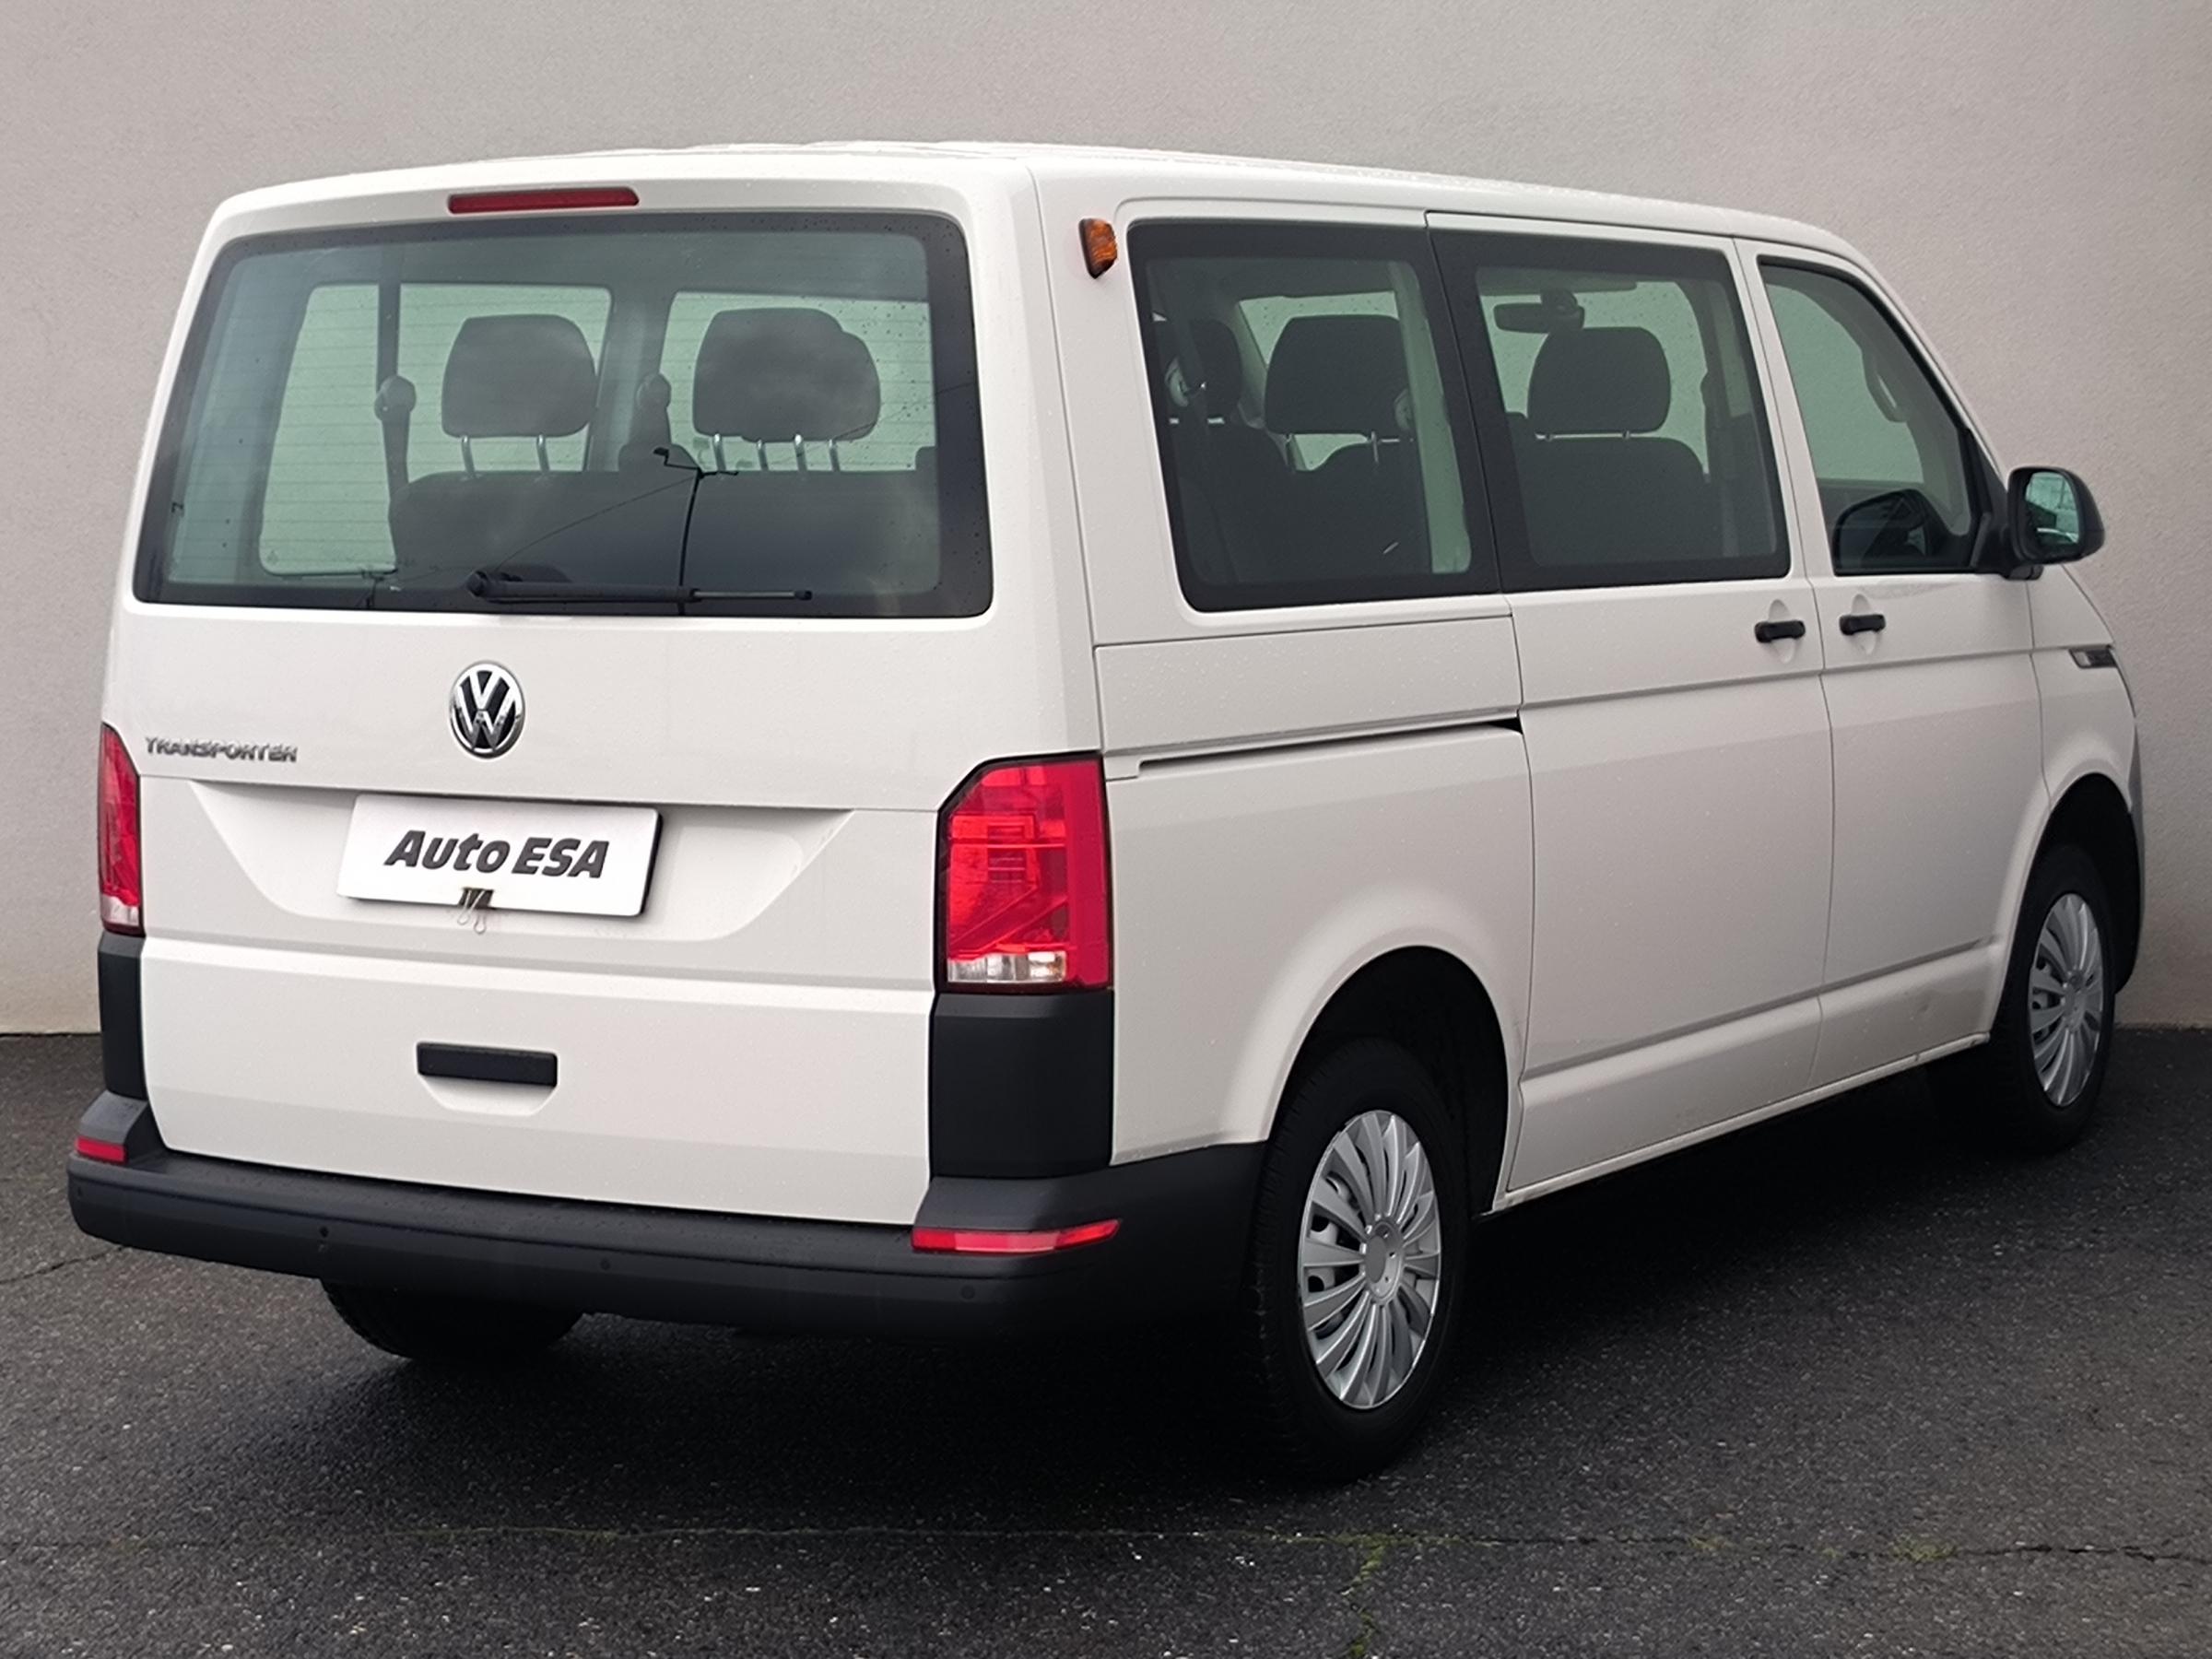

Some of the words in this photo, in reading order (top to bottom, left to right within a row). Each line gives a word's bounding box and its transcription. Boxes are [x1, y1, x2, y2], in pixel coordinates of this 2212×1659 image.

[146, 736, 298, 763] TRANSPORTER
[383, 830, 511, 874] Auto
[511, 837, 609, 878] ESA
